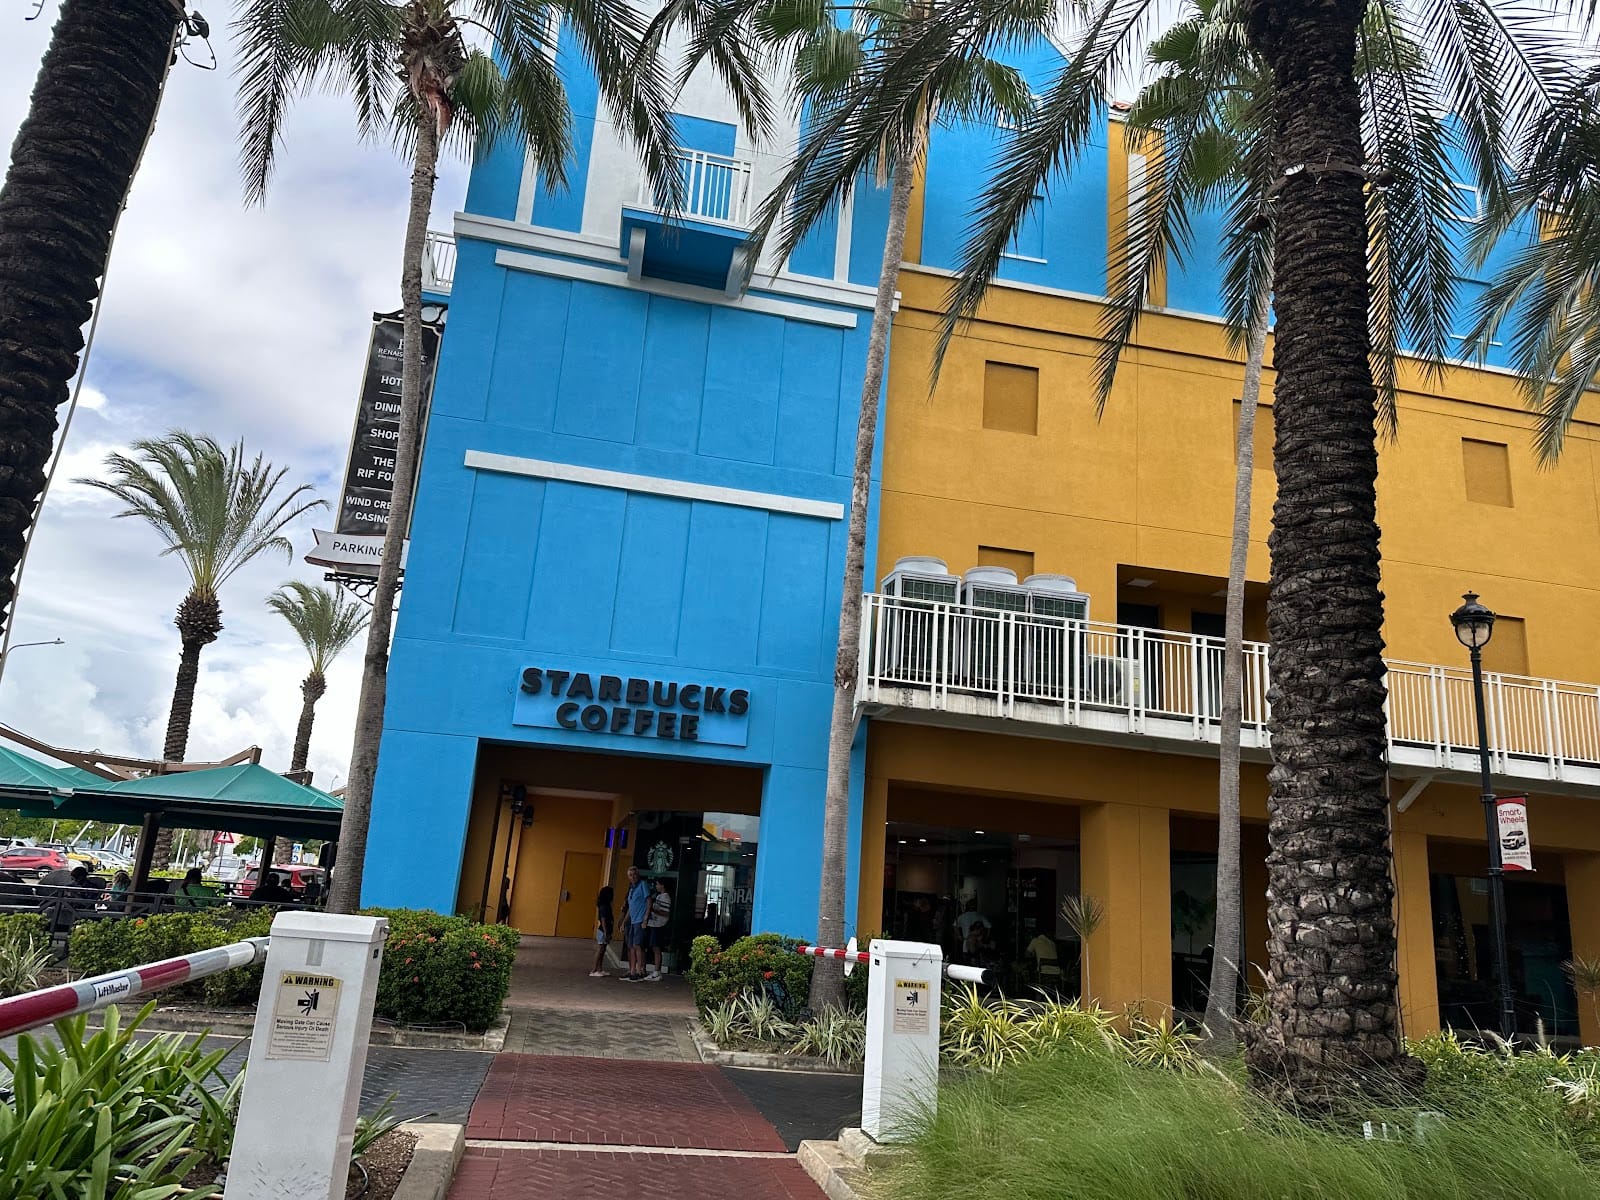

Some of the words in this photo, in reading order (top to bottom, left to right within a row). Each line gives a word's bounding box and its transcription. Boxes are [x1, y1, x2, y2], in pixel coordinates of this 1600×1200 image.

[380, 375, 403, 387] HOT
[370, 428, 399, 441] SHOP
[373, 456, 394, 468] THE
[357, 467, 375, 479] RIF
[377, 471, 395, 482] FO
[345, 495, 371, 507] WIND
[373, 500, 392, 510] CRE
[520, 667, 749, 715] STARBUCKS
[556, 702, 700, 740] COFFEE
[295, 975, 334, 987] WARNING
